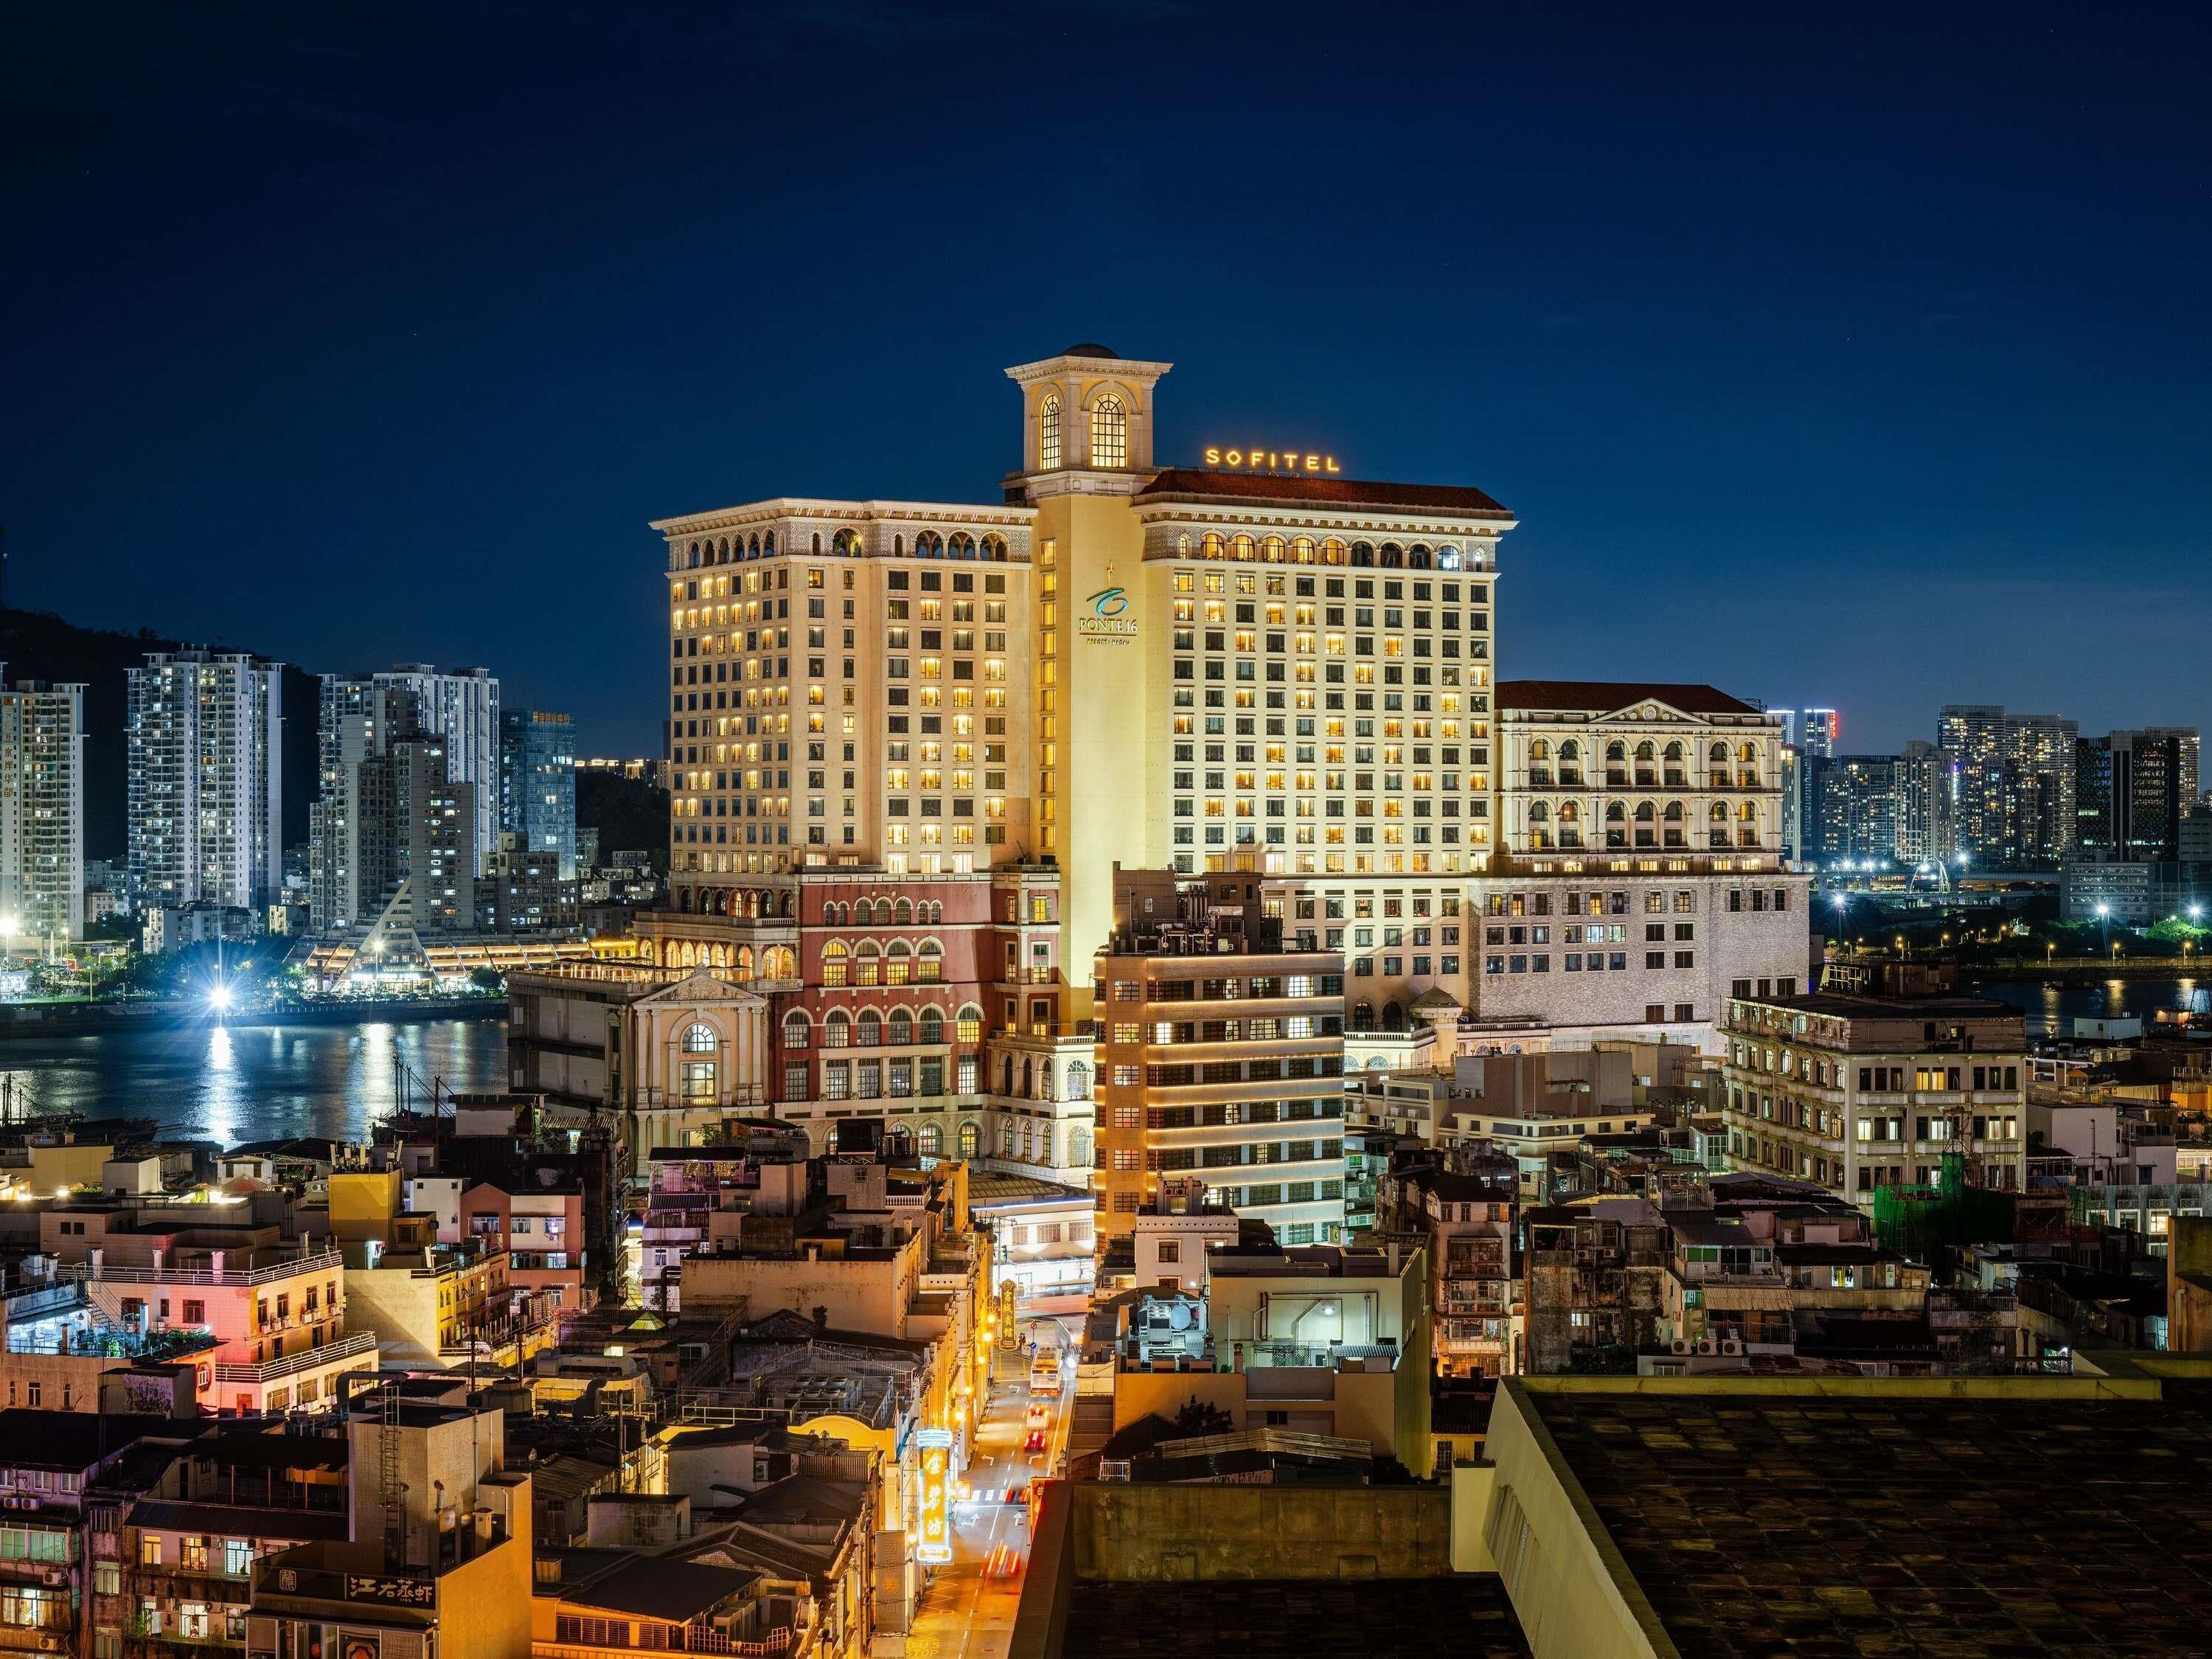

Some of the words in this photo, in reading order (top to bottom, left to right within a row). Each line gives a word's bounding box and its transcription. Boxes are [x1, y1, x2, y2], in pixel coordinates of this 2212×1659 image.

[1206, 449, 1340, 473] SOFITEL
[1079, 618, 1123, 632] PONTE
[1126, 619, 1138, 633] 16
[349, 1576, 434, 1603] 江右蒸虾
[907, 1641, 941, 1649] BUS
[906, 1649, 939, 1658] STOP
